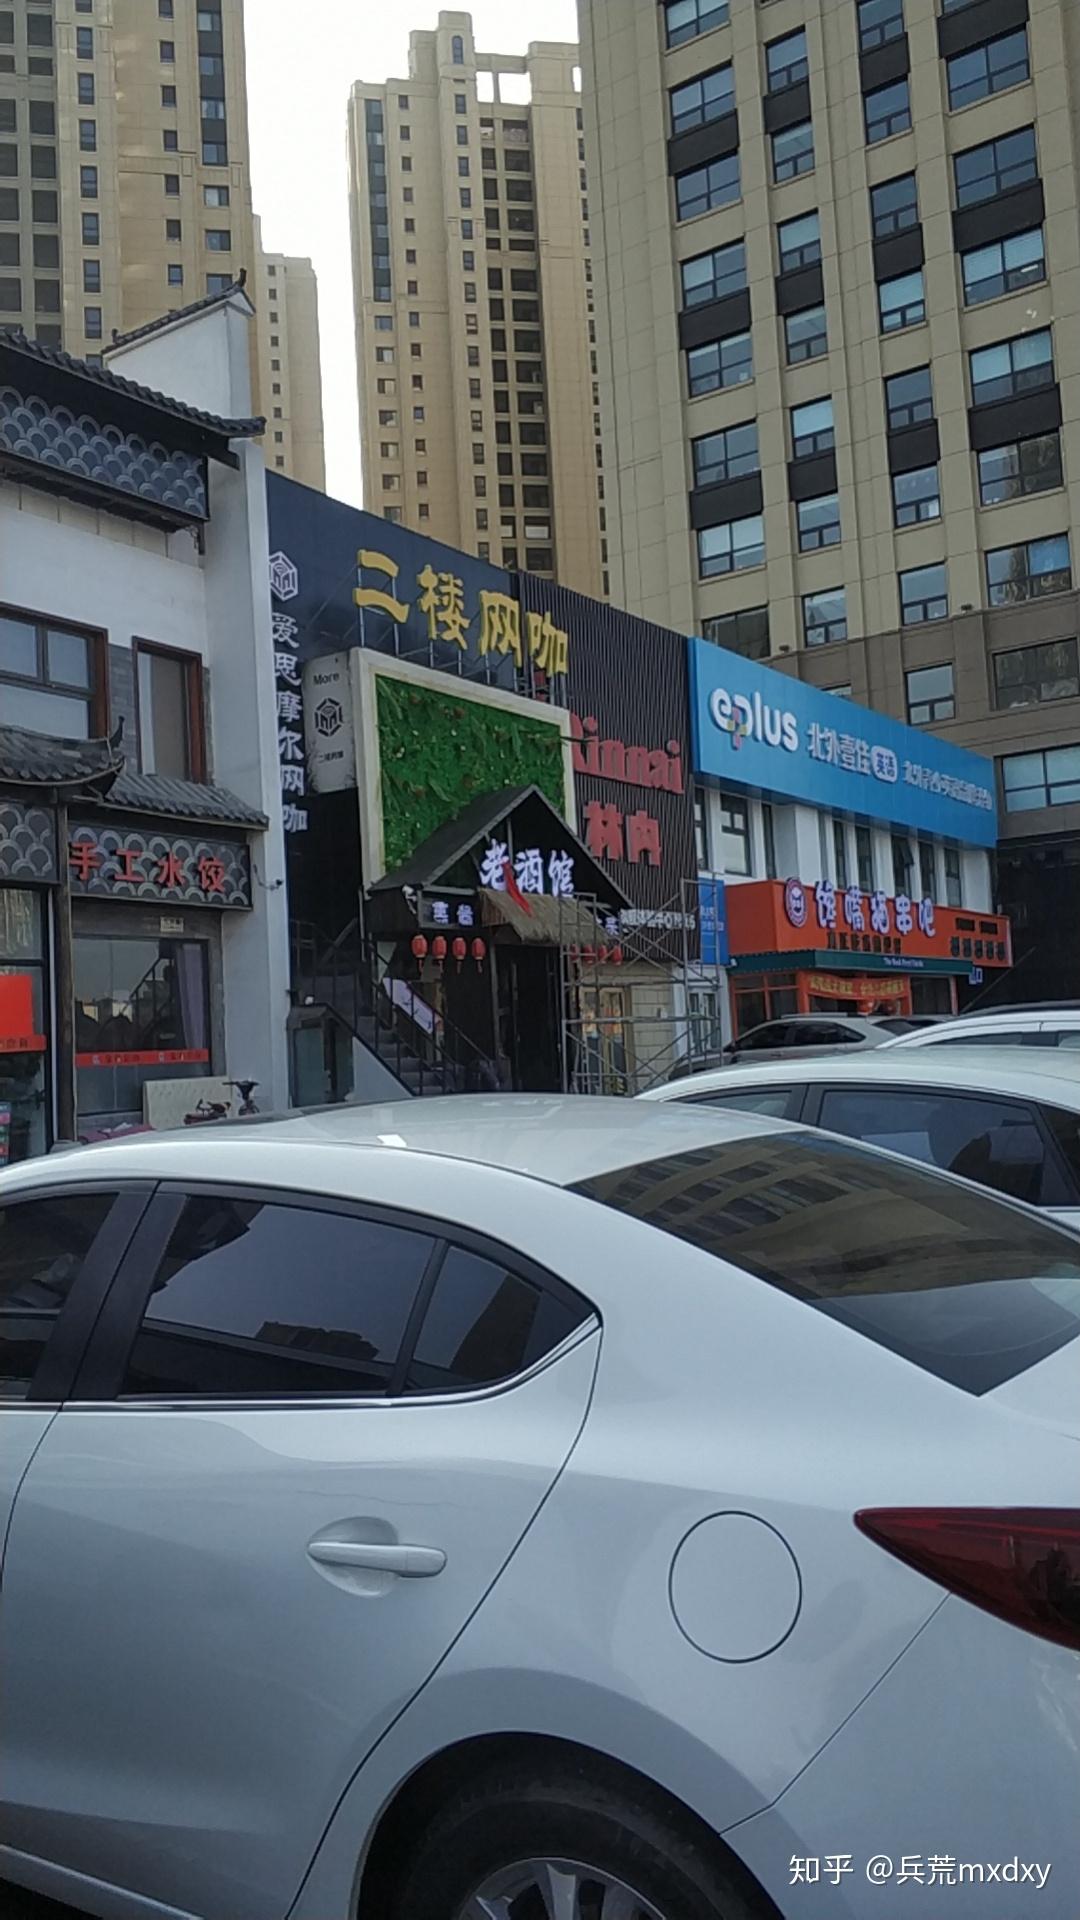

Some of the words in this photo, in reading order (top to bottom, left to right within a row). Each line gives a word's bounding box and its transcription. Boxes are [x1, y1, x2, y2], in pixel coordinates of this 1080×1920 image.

[353, 549, 569, 678] 二楼网咖
[313, 672, 340, 686] More
[272, 612, 308, 833] 爱思摩尔网咖
[709, 687, 799, 752] eplus
[583, 800, 662, 867] 林内
[69, 841, 226, 894] 手工水饺
[480, 838, 575, 898] 老酒馆
